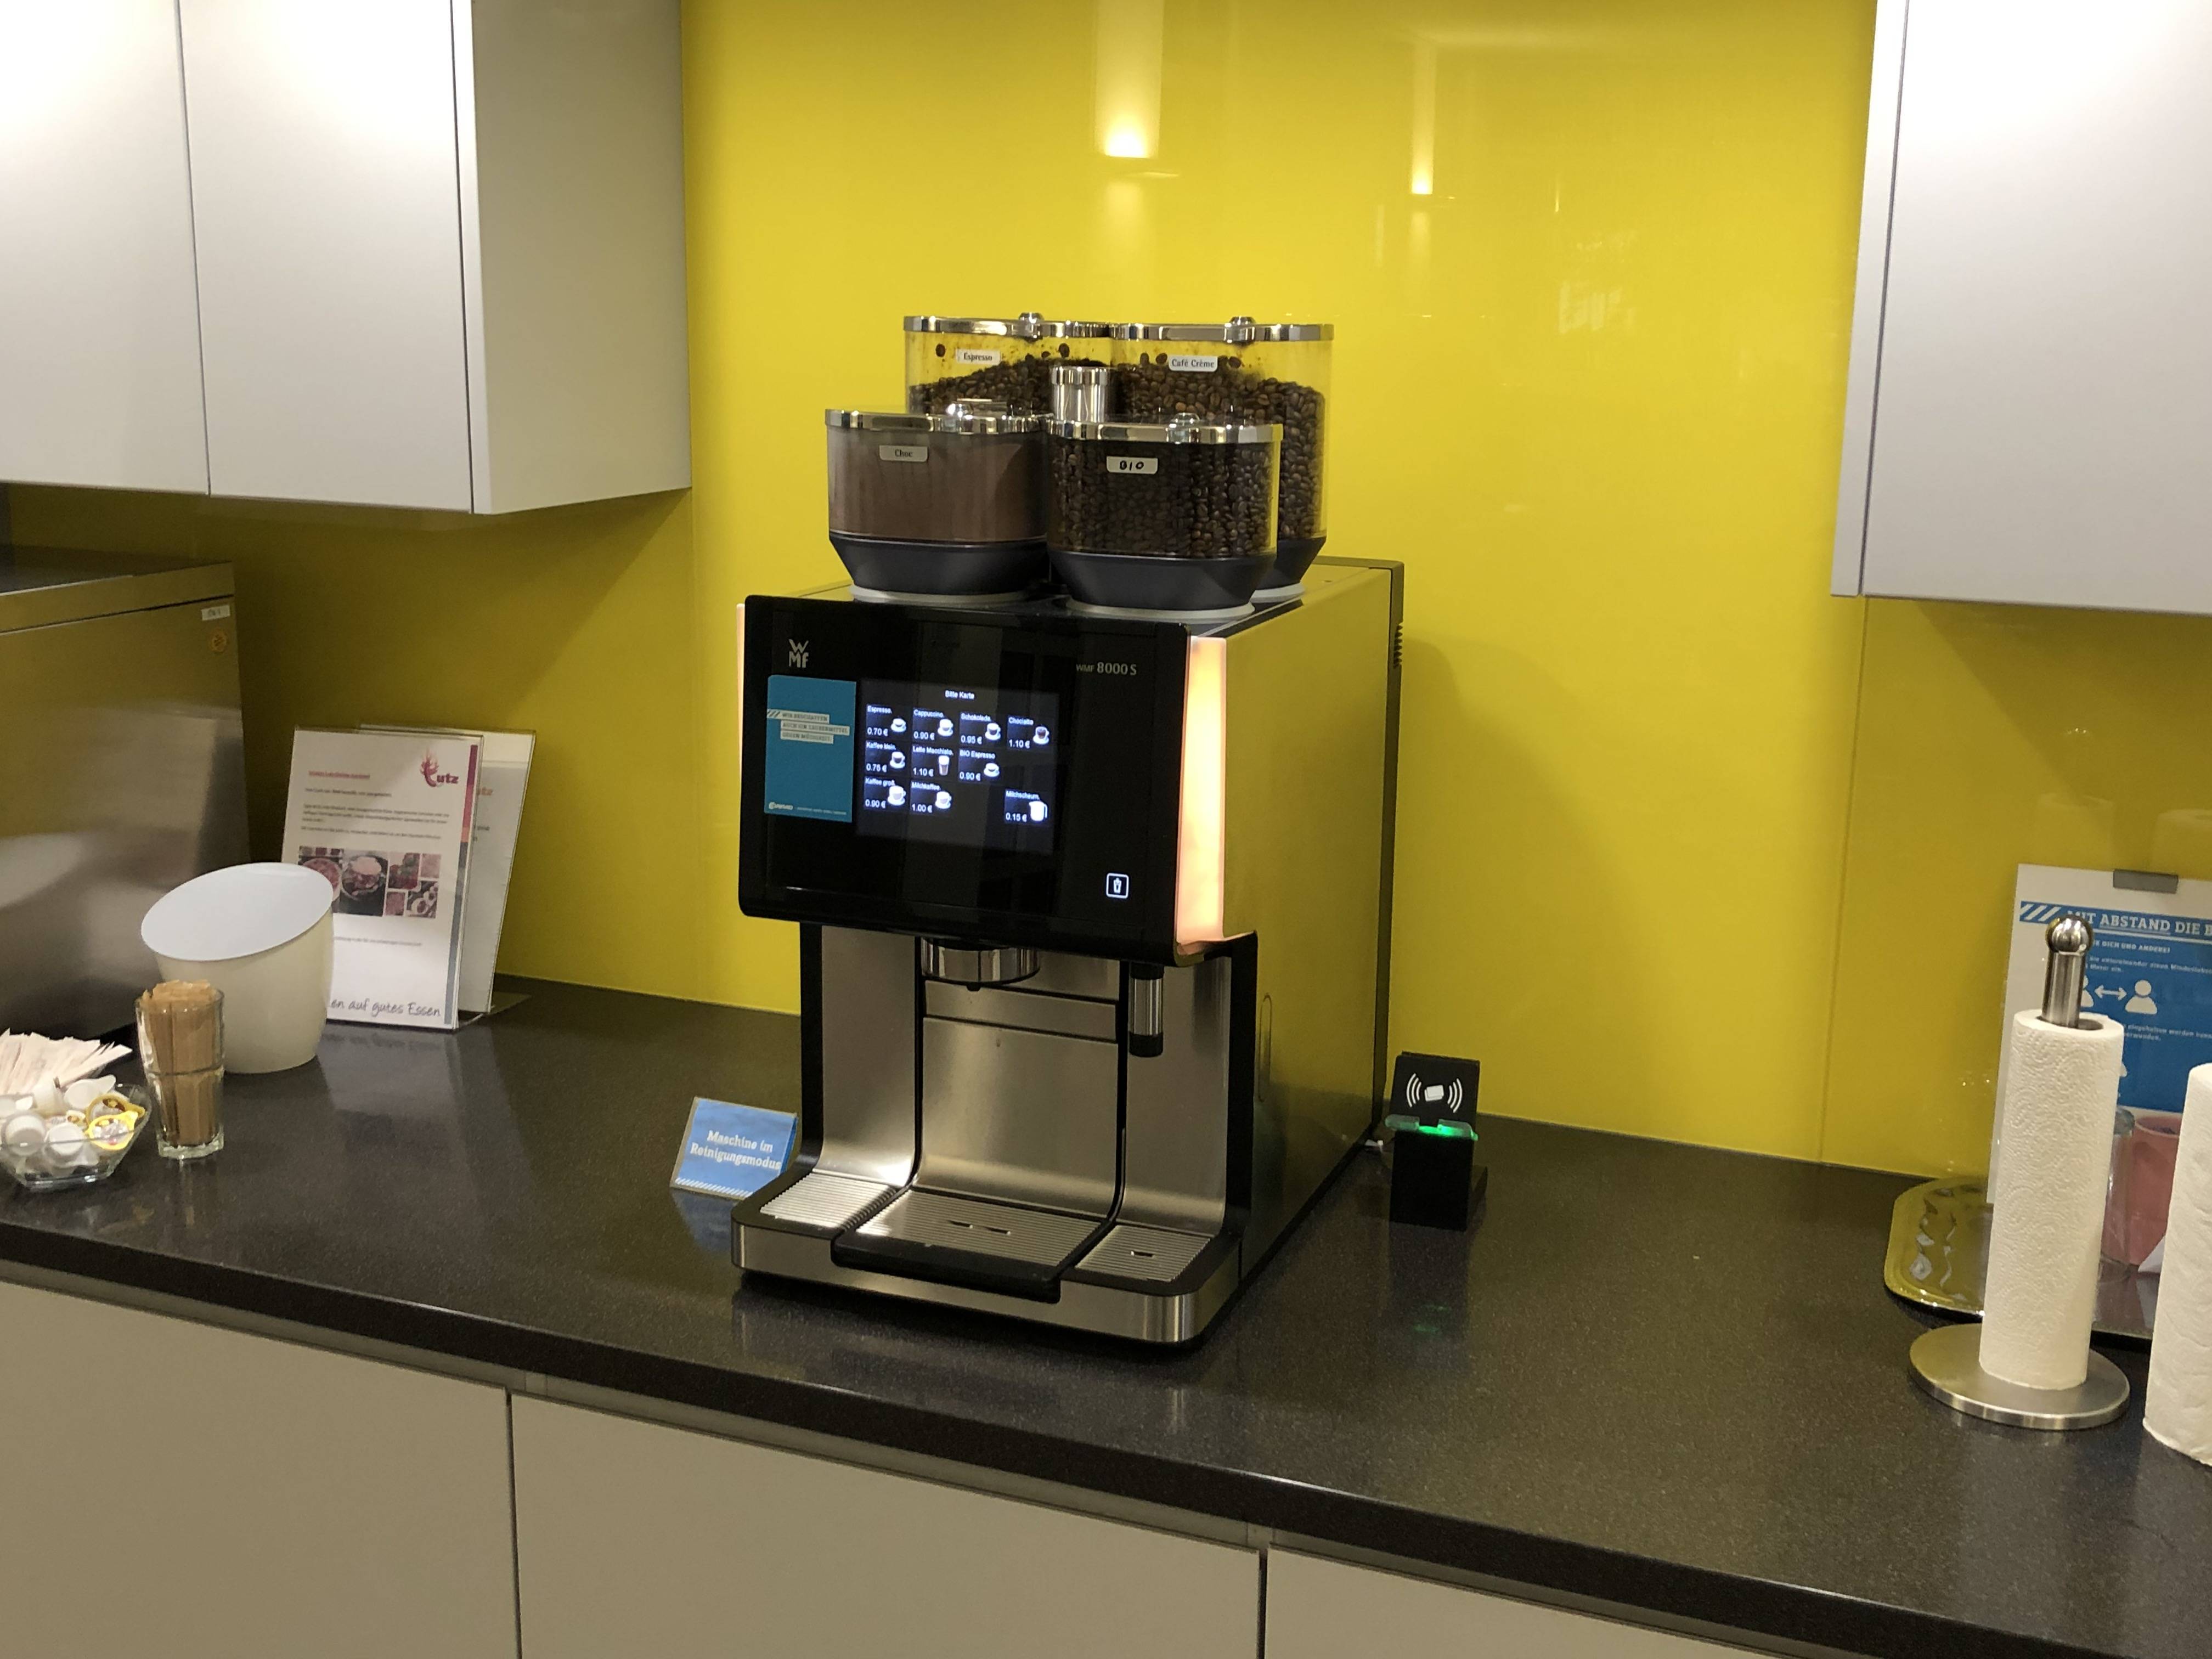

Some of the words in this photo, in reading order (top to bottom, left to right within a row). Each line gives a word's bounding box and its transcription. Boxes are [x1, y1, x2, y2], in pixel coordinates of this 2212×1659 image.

[963, 352, 992, 362] Espresso
[1172, 358, 1189, 367] Café
[1191, 358, 1215, 368] Crème
[894, 448, 913, 458] Choc
[1119, 460, 1144, 471] BIO
[1076, 663, 1095, 673] WMF
[1097, 661, 1128, 675] 8000
[1130, 663, 1137, 676] S
[945, 690, 958, 698] Bitte
[960, 691, 975, 699] Karte
[867, 726, 882, 736] 0.70
[883, 727, 889, 737] €
[929, 732, 935, 741] €
[866, 741, 883, 750] Kaffee
[977, 736, 983, 745] €
[1008, 739, 1024, 748] 1.10
[1025, 740, 1030, 749] €
[970, 750, 996, 759] Espresso
[882, 764, 887, 773] €
[912, 767, 928, 777] 1.10
[928, 768, 934, 778] €
[865, 777, 882, 786] Kaffee
[975, 772, 981, 782] €
[881, 800, 887, 809] €
[927, 804, 933, 814] €
[1005, 812, 1020, 822] 0.15
[1022, 814, 1028, 823] €
[2100, 913, 2171, 932] ABSTAND
[2175, 921, 2200, 936] DIE
[348, 997, 370, 1012] auf
[371, 1001, 404, 1018] gutes
[407, 1001, 441, 1017] Essen
[706, 1129, 758, 1150] Maschine
[759, 1139, 774, 1153] im
[690, 1141, 782, 1171] Reinigungsmodus
